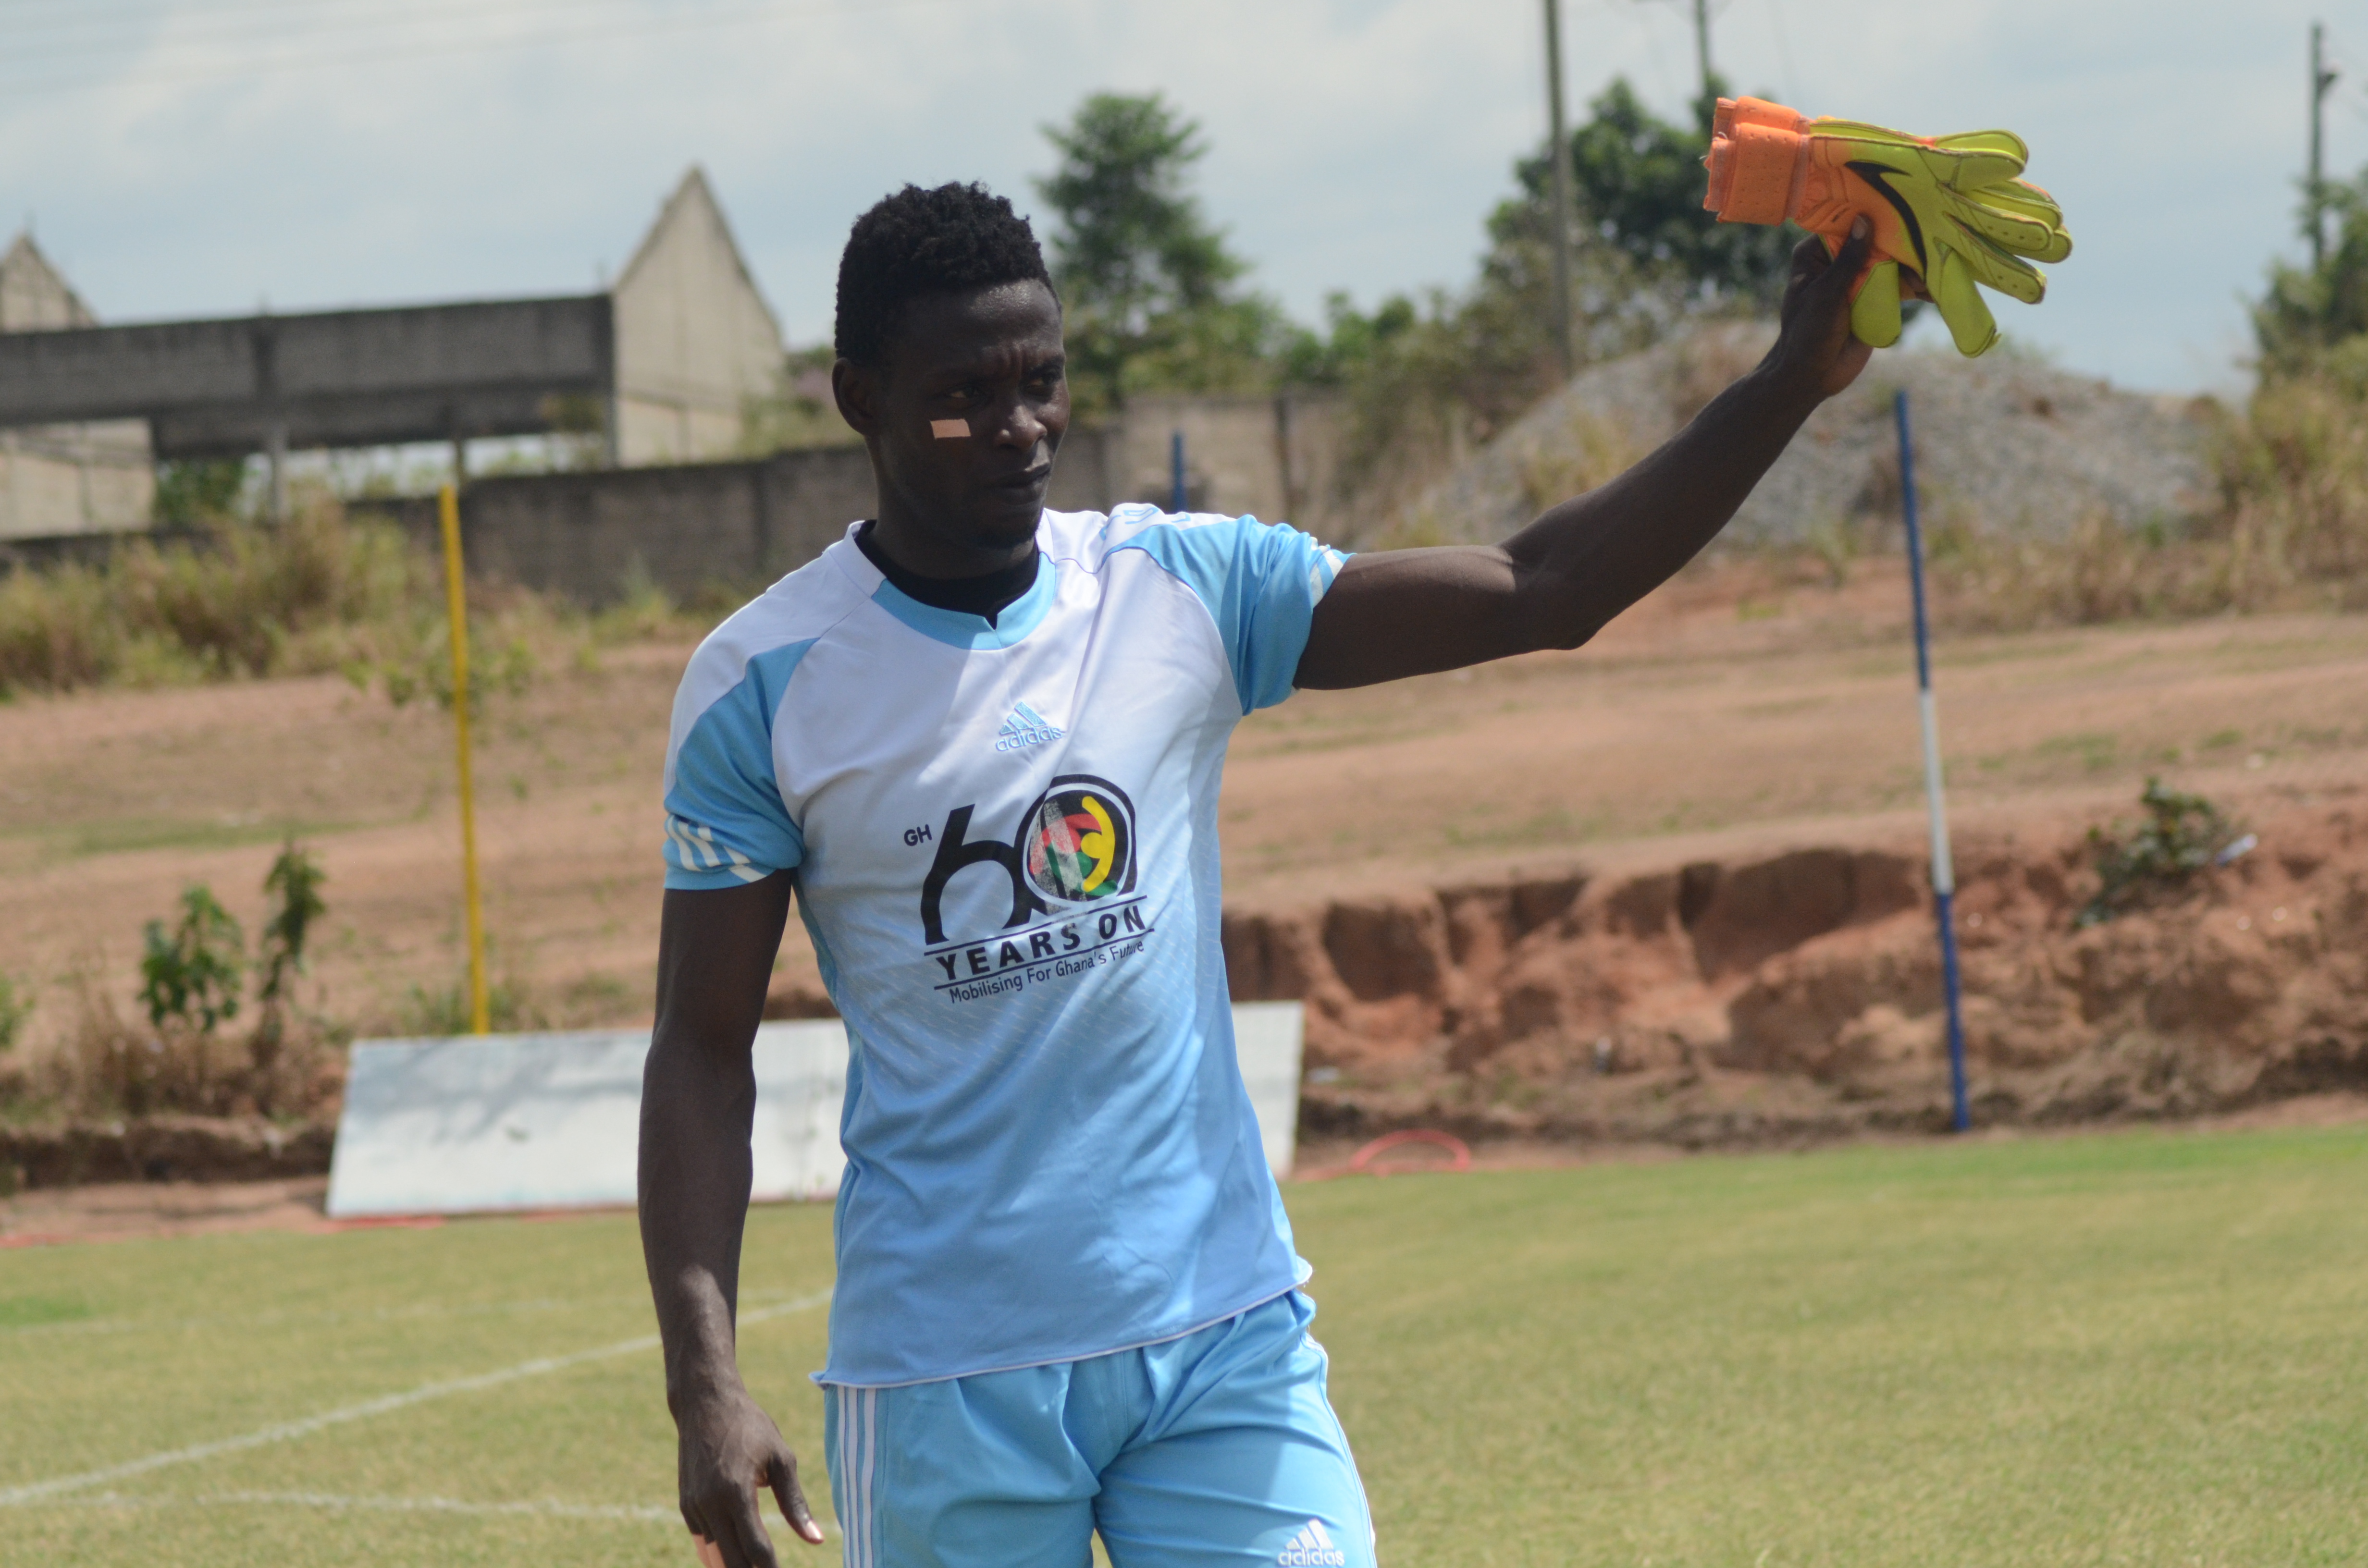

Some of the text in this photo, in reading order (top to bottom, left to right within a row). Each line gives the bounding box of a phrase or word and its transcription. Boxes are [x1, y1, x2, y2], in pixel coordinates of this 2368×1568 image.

[996, 725, 1065, 751] adidas
[904, 824, 932, 846] GH
[936, 905, 1146, 981] YEARS ON
[950, 939, 1145, 1004] Mobilising For Ghana's Future
[1277, 1547, 1345, 1567] adidas
